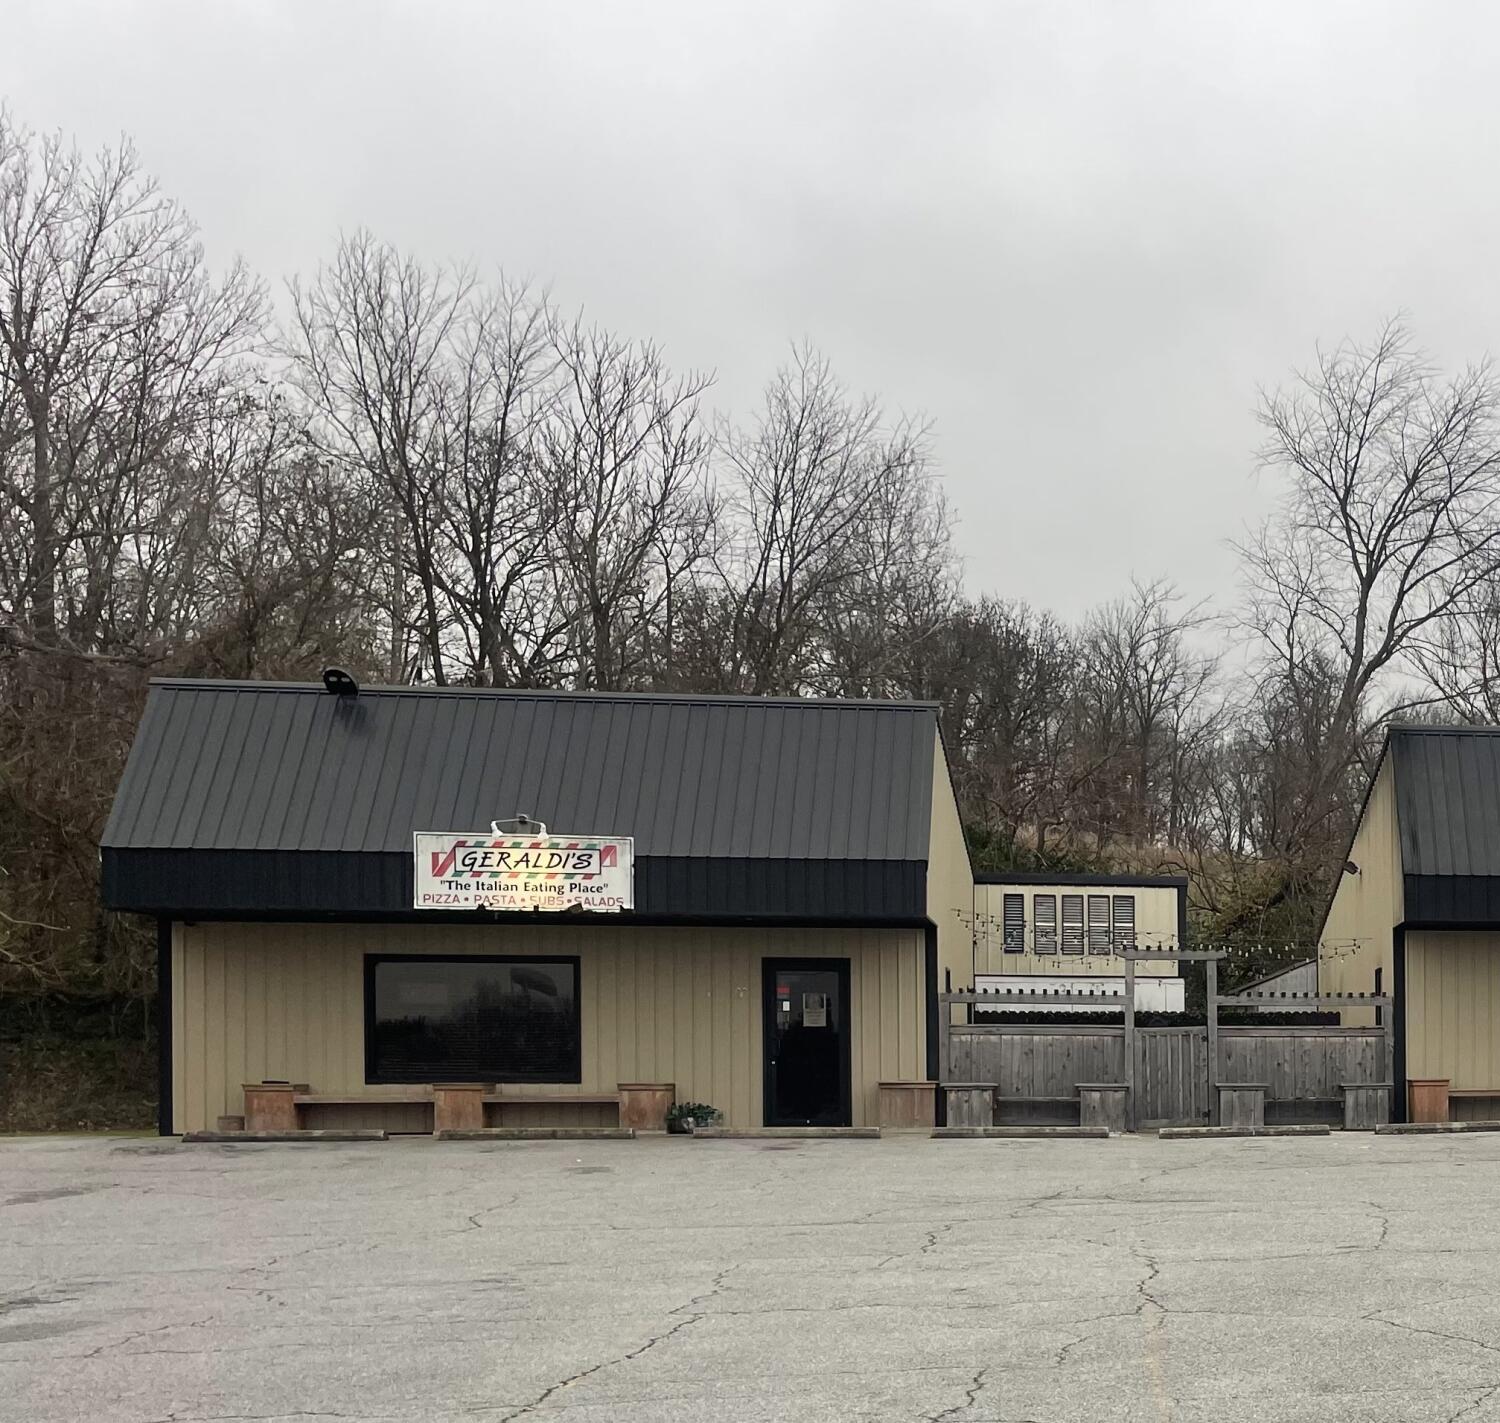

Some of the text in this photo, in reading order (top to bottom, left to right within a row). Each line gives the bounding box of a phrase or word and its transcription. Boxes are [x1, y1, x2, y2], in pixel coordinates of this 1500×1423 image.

[461, 850, 592, 871] GERALDI'S
[440, 880, 609, 895] "The Italian Eating Place"
[423, 893, 624, 907] PIZZA PASTA SUBS SALADS
